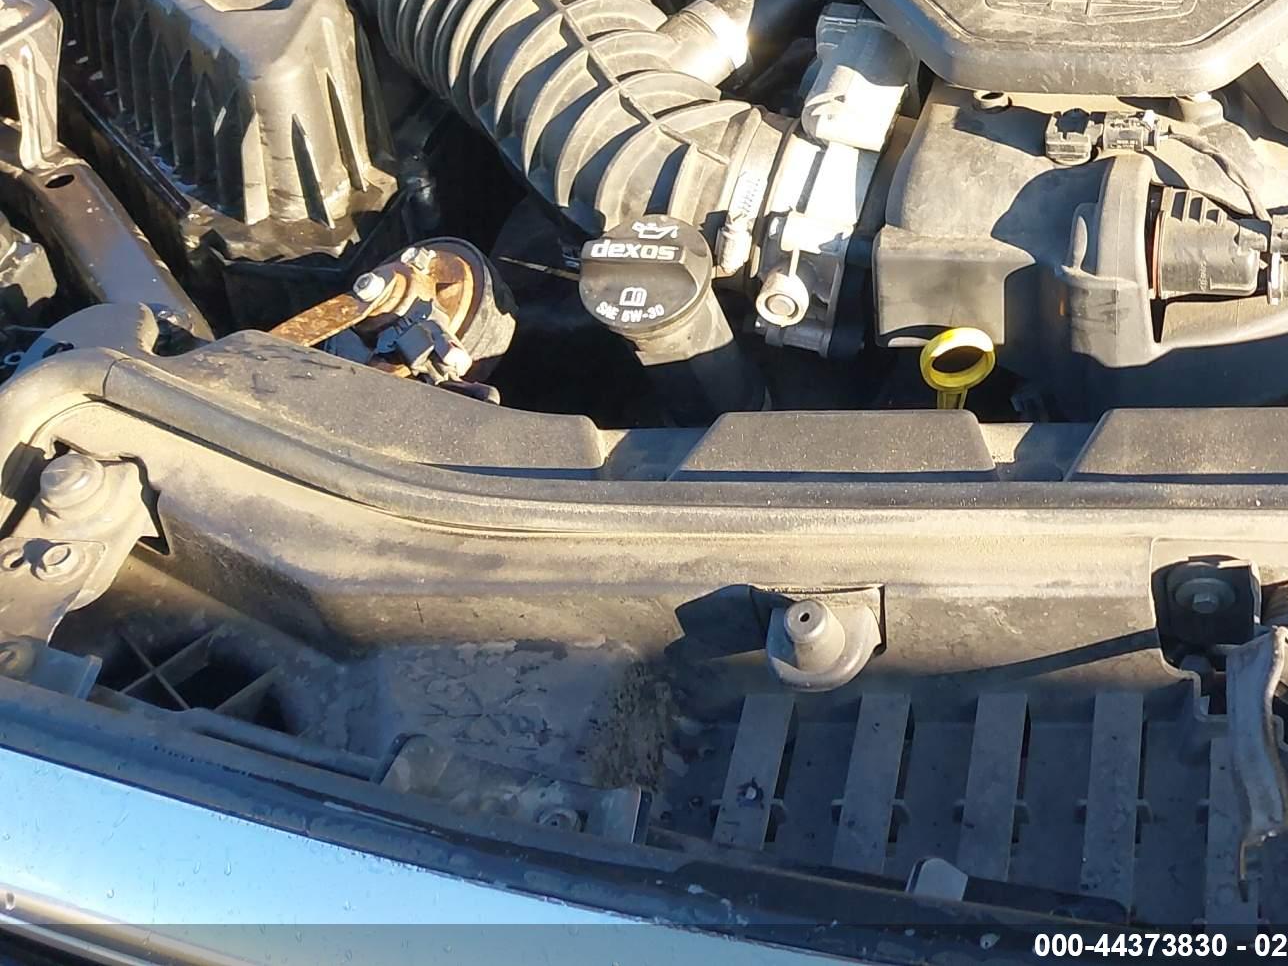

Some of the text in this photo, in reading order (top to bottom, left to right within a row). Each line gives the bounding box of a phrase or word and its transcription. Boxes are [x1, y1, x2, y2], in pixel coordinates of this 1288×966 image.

[590, 239, 679, 260] dexos
[596, 301, 664, 322] SAE 5W-30
